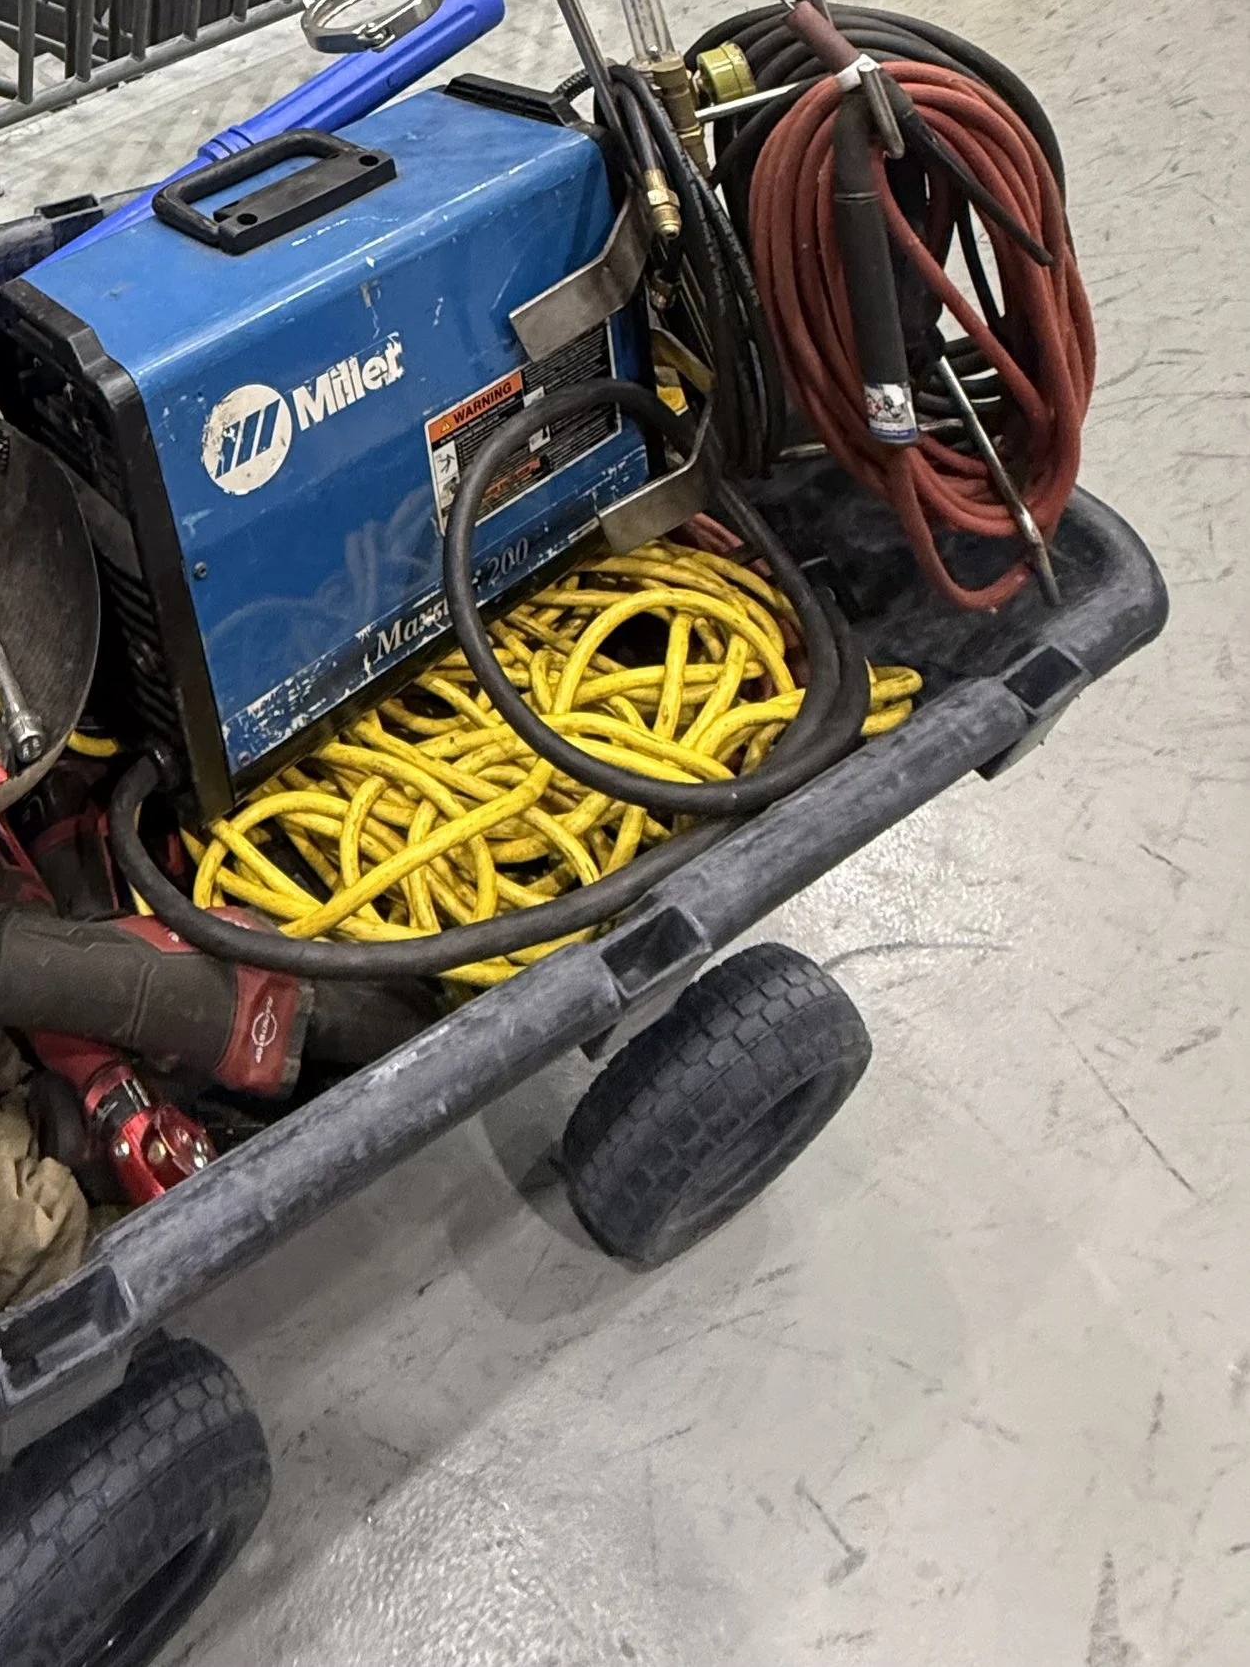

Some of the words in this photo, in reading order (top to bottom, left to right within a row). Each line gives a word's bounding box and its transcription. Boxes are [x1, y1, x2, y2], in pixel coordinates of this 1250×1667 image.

[292, 334, 404, 432] Miller
[453, 381, 513, 425] WARNING
[488, 537, 529, 587] 200
